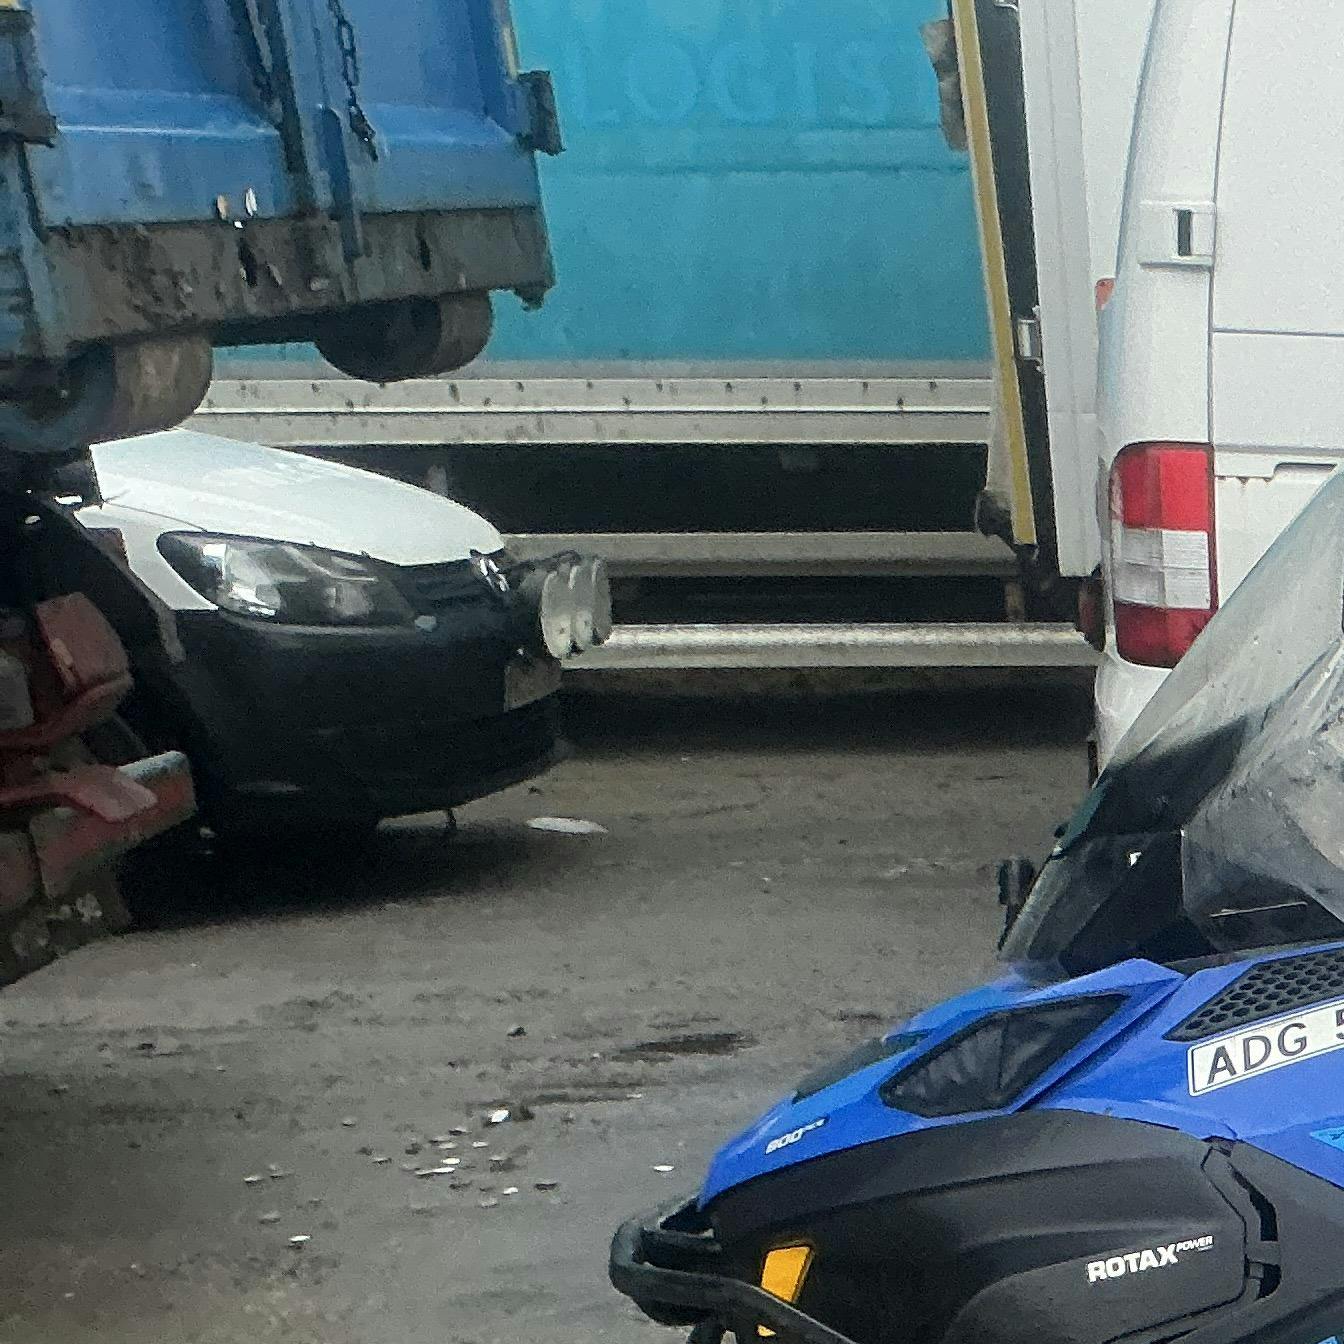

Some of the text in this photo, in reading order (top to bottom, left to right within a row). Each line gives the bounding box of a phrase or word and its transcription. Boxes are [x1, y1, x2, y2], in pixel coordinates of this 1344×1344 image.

[1207, 1021, 1308, 1086] ADG
[1087, 1235, 1213, 1282] ROTAX POWER
